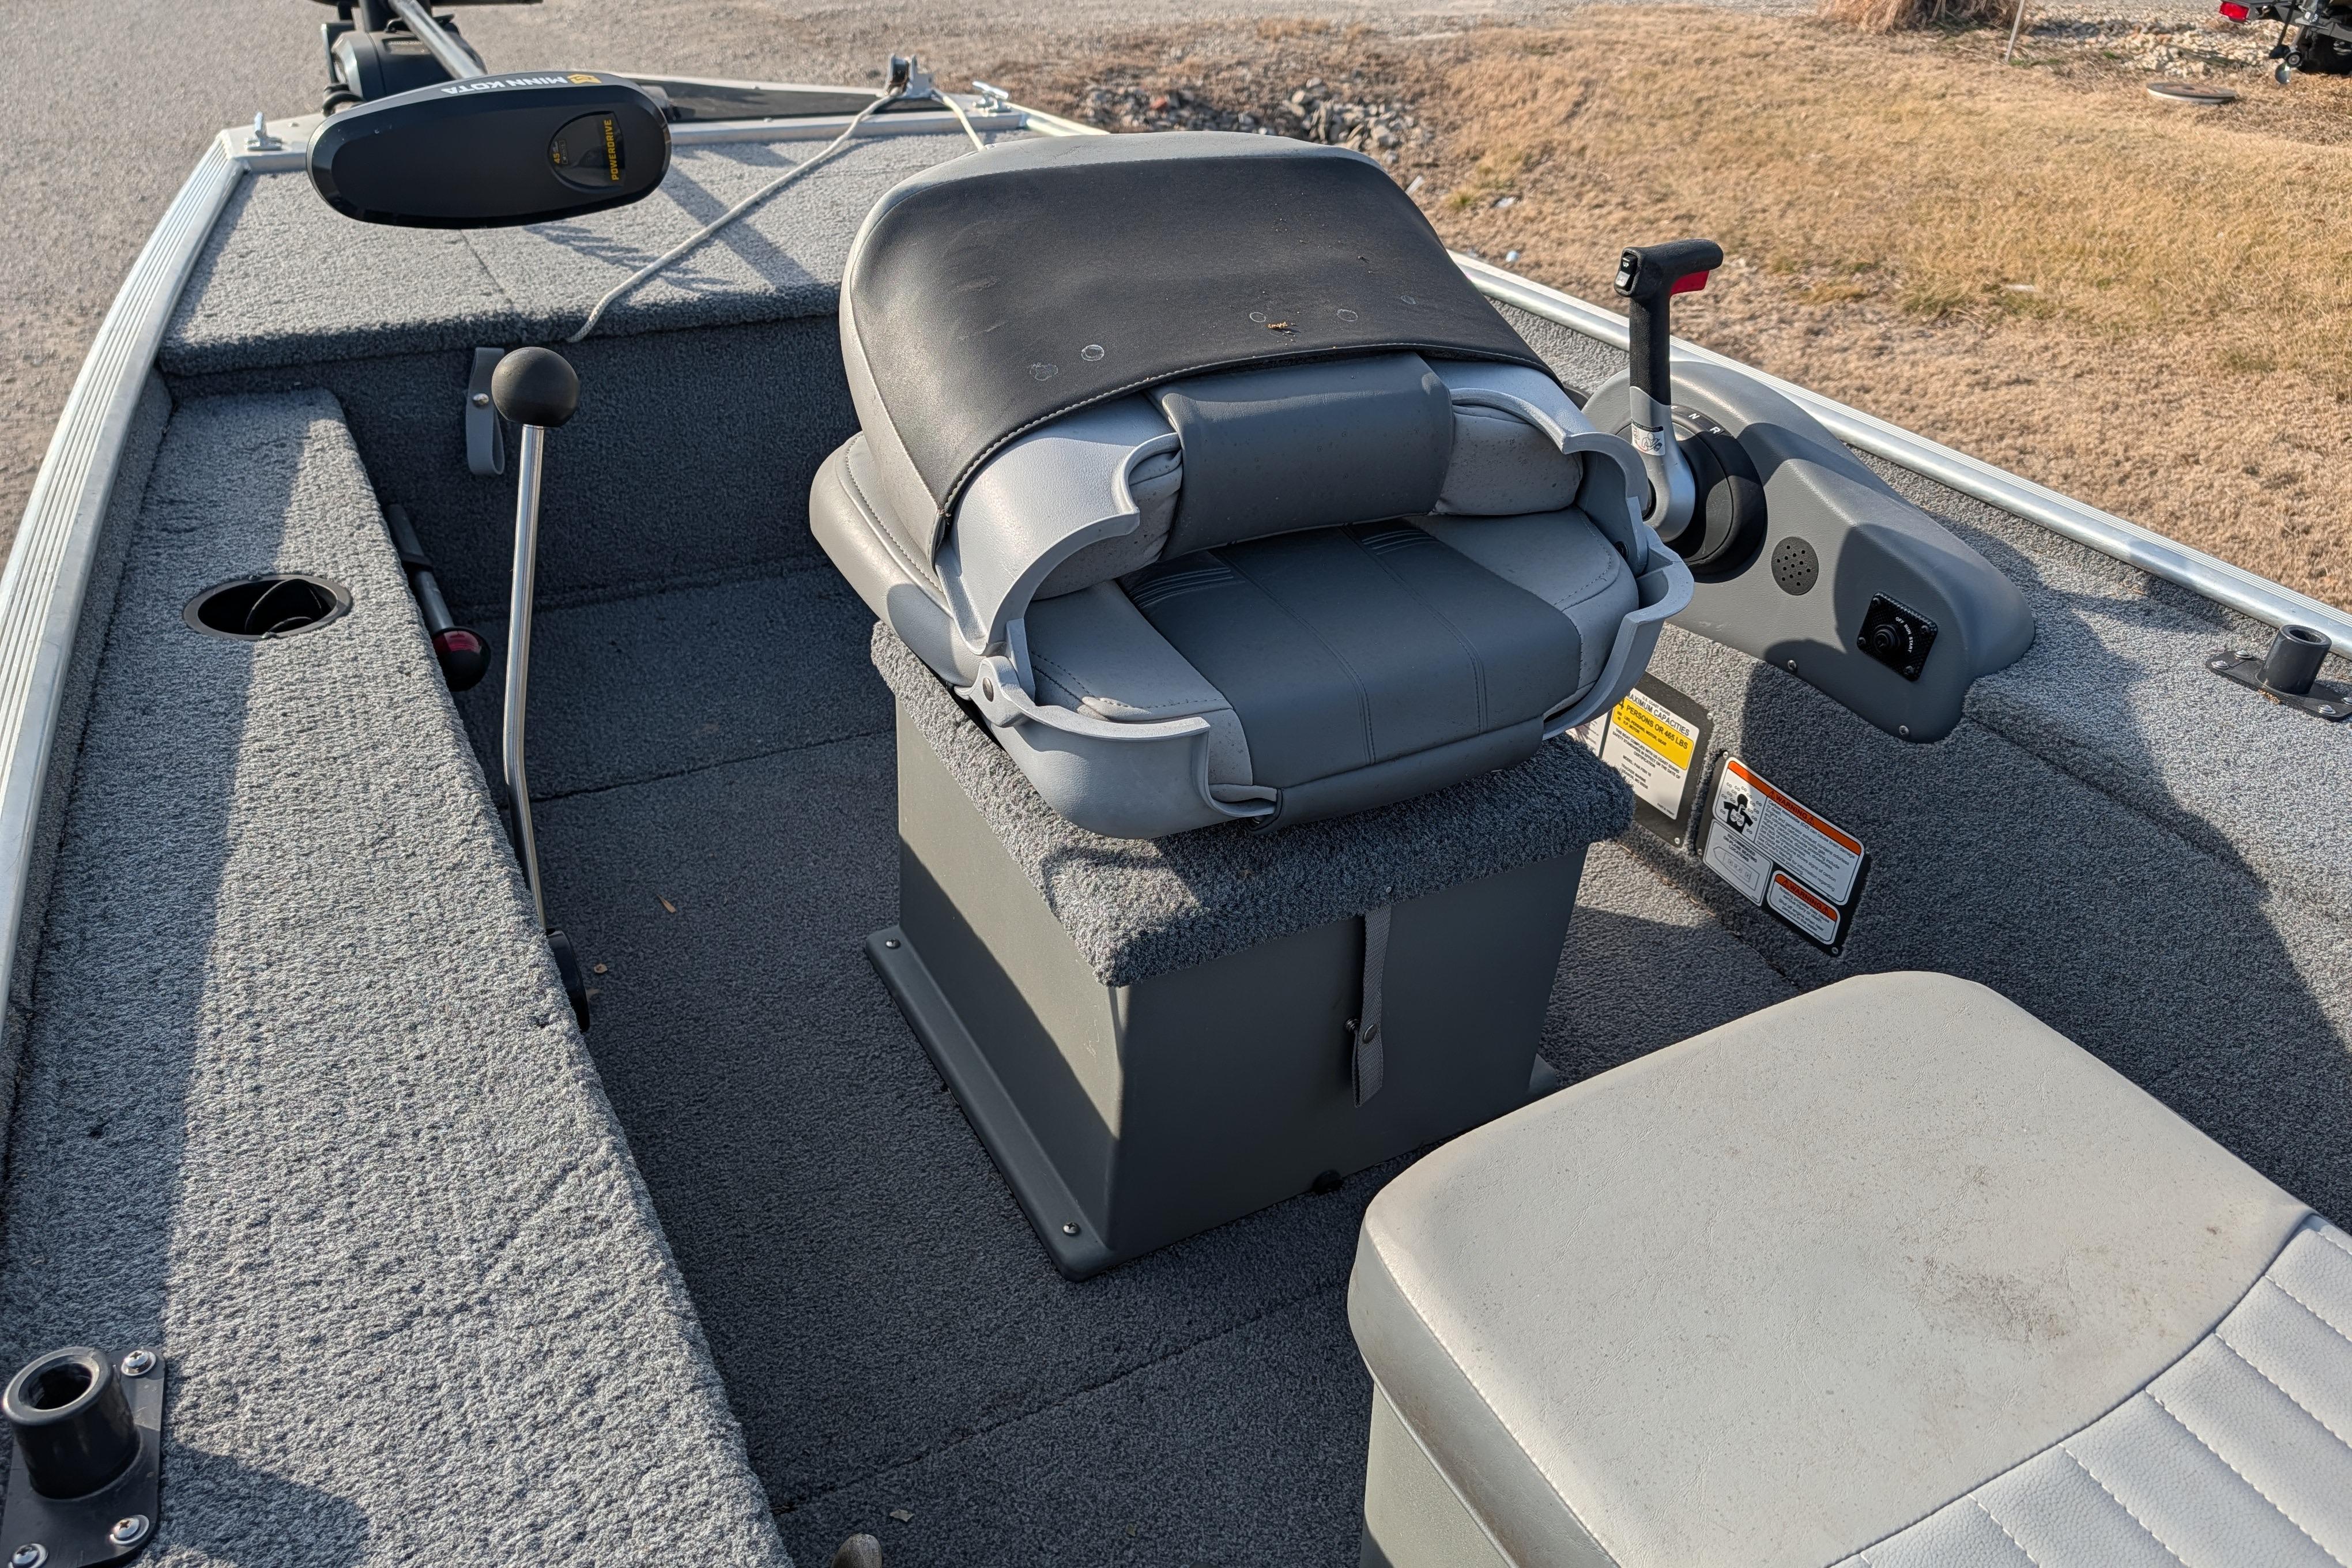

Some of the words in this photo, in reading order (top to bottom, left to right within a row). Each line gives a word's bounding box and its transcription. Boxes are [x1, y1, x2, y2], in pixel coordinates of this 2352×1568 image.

[441, 81, 506, 94] KOTA
[506, 76, 568, 86] MINN
[553, 153, 560, 164] 45
[604, 119, 620, 180] POWERDRIVE
[1709, 426, 1721, 434] R
[1904, 624, 1912, 635] RUN
[1649, 700, 1659, 708] COAST
[1659, 706, 1671, 716] GUARD
[1626, 705, 1654, 727] PERSONS
[1654, 723, 1664, 734] OR
[1664, 730, 1675, 741] 465
[1675, 736, 1688, 749] LBS
[1653, 710, 1690, 736] CAPACITIES
[1612, 731, 1623, 740] SAFETY
[1623, 738, 1641, 753] STANDARDS
[1644, 753, 1656, 763] EFFECT
[1667, 768, 1676, 777] DATE
[1630, 738, 1645, 750] COMPLIES
[1657, 757, 1668, 765] COAST
[1668, 764, 1679, 773] GUARD
[1634, 751, 1655, 768] CERTIFICATION
[1622, 763, 1634, 775] TRACKER
[1635, 773, 1646, 782] MARINE
[1776, 796, 1807, 819] WARNING
[1759, 832, 1776, 846] monoxide
[1765, 808, 1778, 820] Engine
[1785, 822, 1802, 835] generator
[1802, 834, 1816, 845] exhaust
[1817, 843, 1833, 855] contains
[1833, 853, 1849, 865] odorless
[1768, 800, 1781, 811] Carbon
[1781, 810, 1800, 823] monoxide
[1800, 821, 1810, 831] (CO)
[1817, 834, 1829, 842] cause
[1829, 840, 1839, 849] brain
[1839, 847, 1855, 859] damage
[1771, 817, 1786, 830] colorless
[1787, 828, 1800, 838] carbon
[1800, 836, 1818, 850] monoxide
[1723, 836, 1741, 851] ON-PLANE
[1742, 849, 1757, 862] SEATING
[1727, 834, 1755, 856] RECOMMENDED
[1729, 845, 1749, 862] LOCATIONS
[1757, 840, 1768, 850] carbon
[1769, 849, 1785, 862] monoxide
[1763, 816, 1773, 825] Signs
[1777, 827, 1789, 836] carbon
[1790, 835, 1807, 848] monoxide
[1807, 847, 1826, 861] poisoning
[1826, 858, 1840, 869] include
[1776, 830, 1793, 844] headache,
[1812, 854, 1833, 871] drowsiness,
[1766, 832, 1775, 840] fresh
[1783, 845, 1796, 855] anyone
[1796, 854, 1808, 864] shows
[1808, 862, 1818, 870] signs
[1823, 872, 1836, 882] carbon
[1797, 864, 1817, 879] information
[1817, 877, 1835, 892] regarding
[1779, 886, 1793, 899] Rotating
[1793, 898, 1810, 910] propeller
[1818, 914, 1829, 923] cause
[1790, 884, 1822, 907] WARNING
[1792, 909, 1804, 918] engine
[1796, 903, 1807, 913] injury
